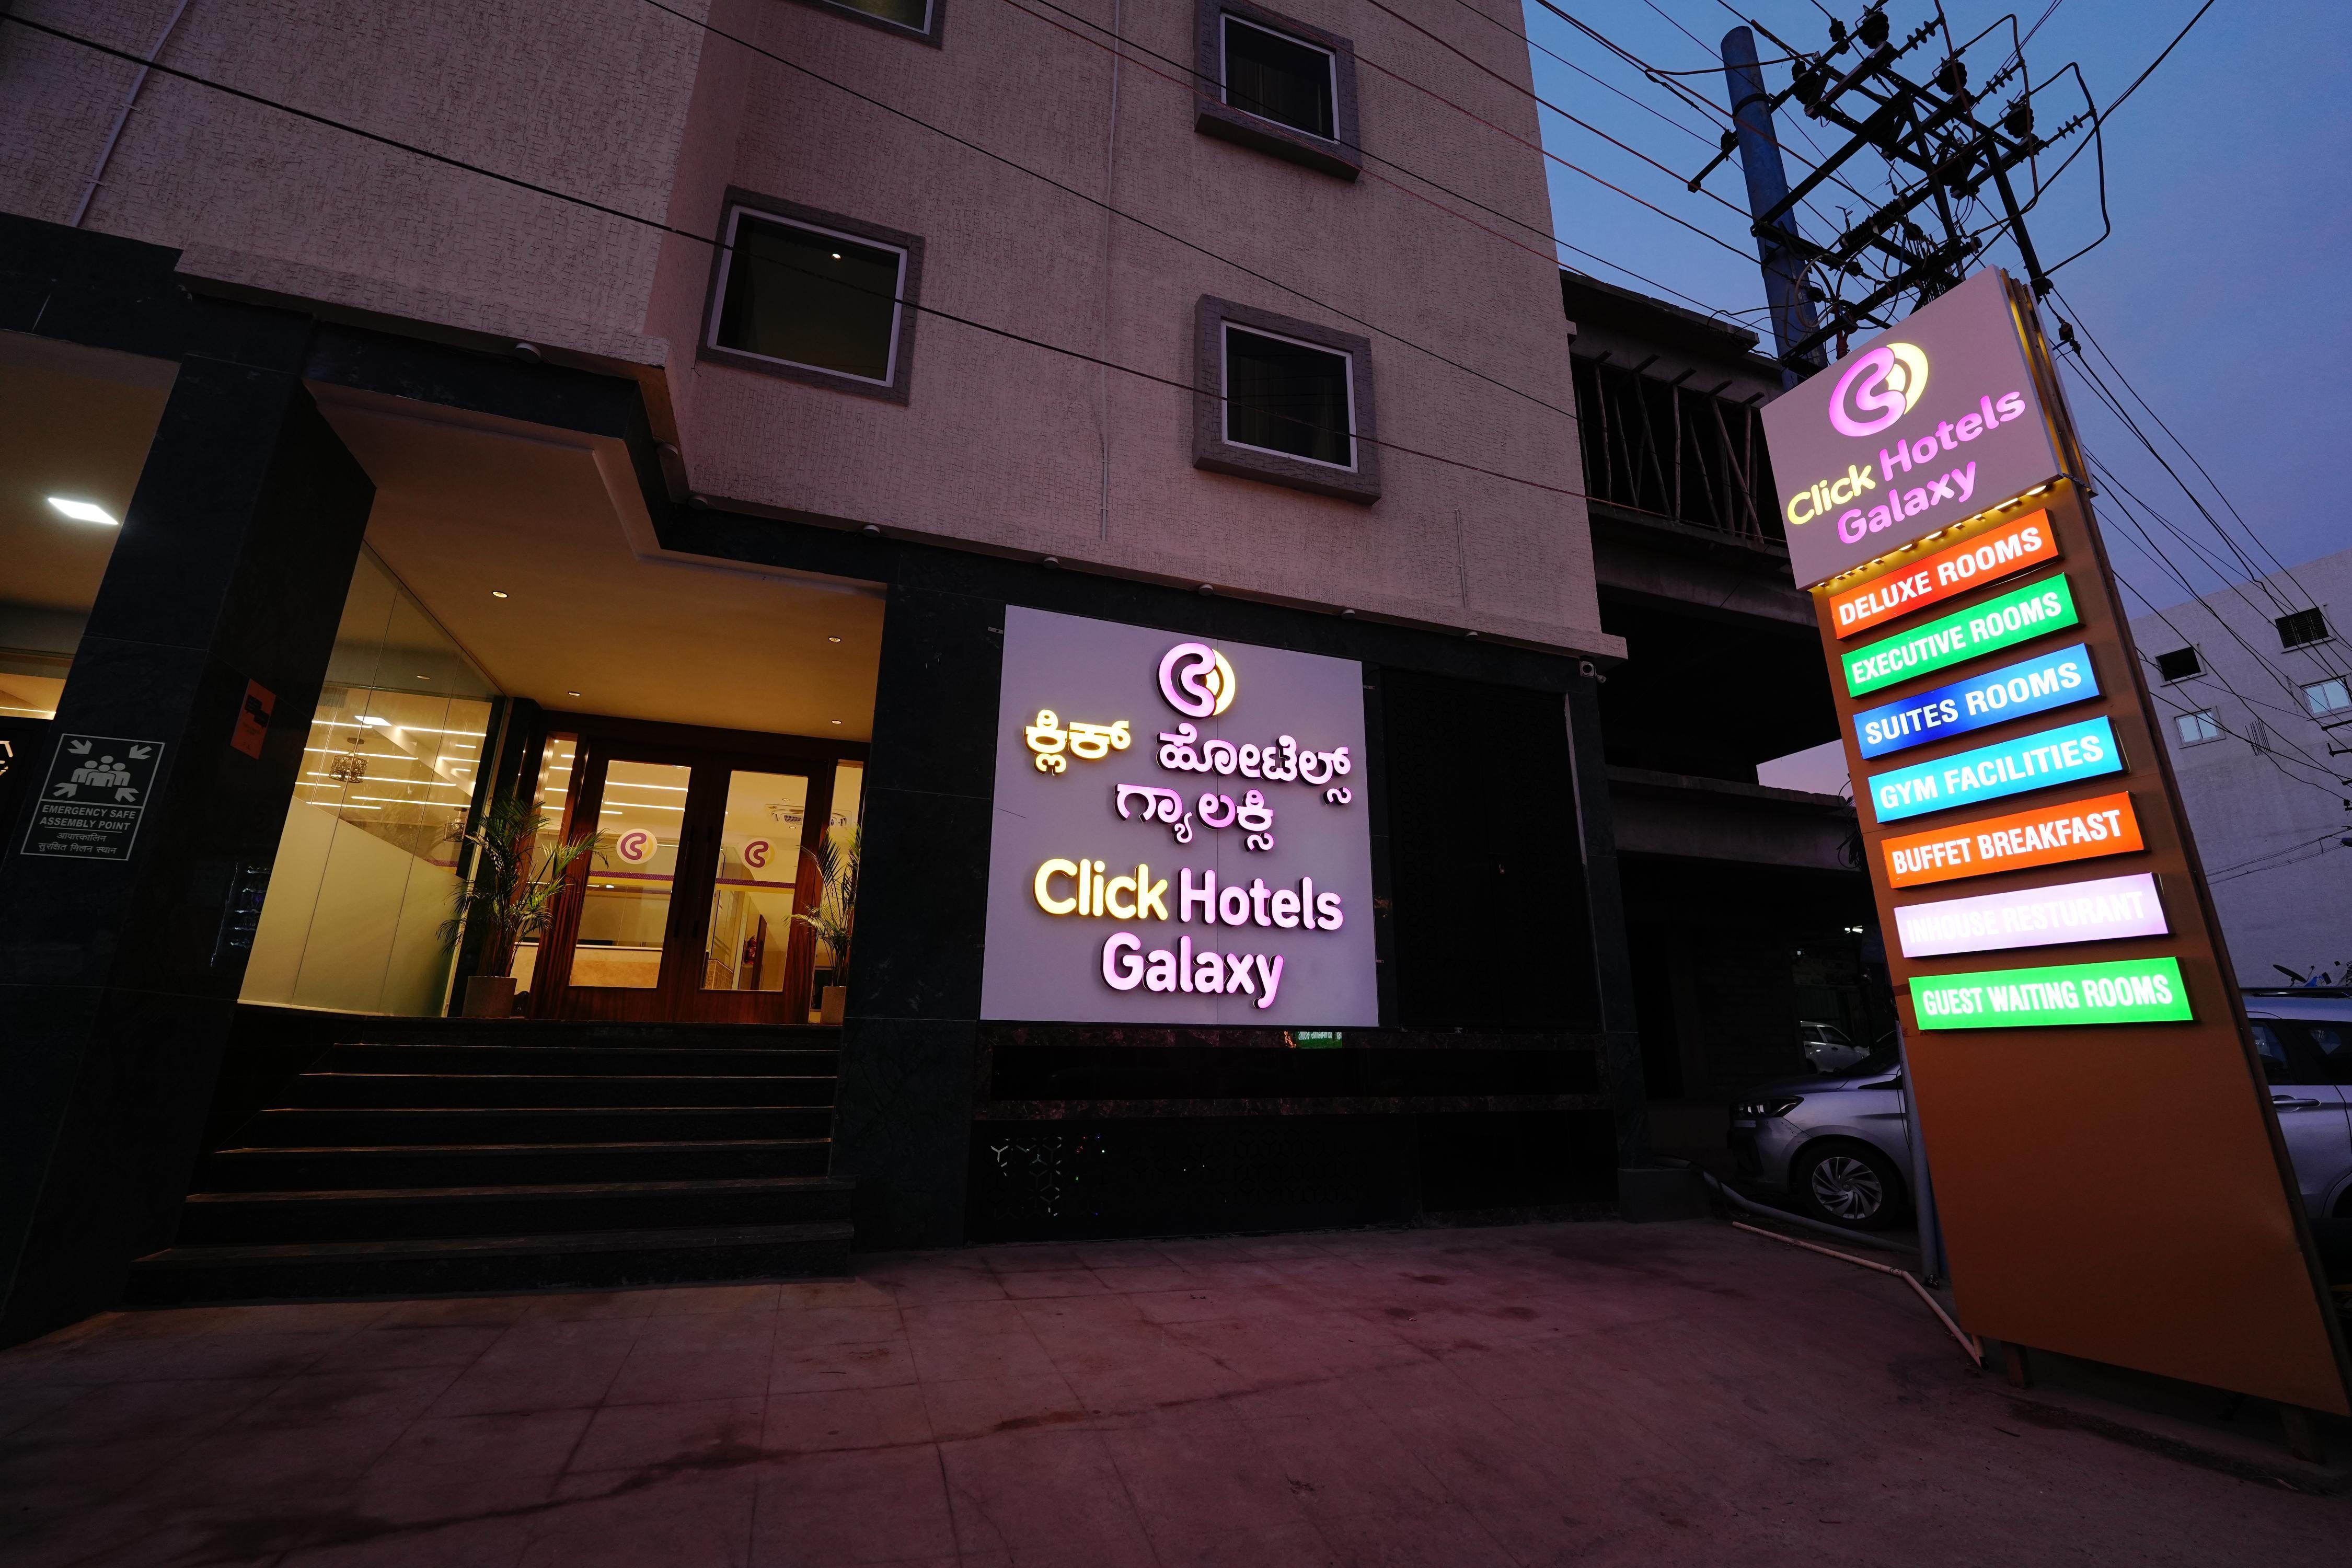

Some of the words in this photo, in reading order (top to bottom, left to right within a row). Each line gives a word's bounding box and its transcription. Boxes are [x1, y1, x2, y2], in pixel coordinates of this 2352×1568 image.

[1787, 464, 1876, 525] Click
[1878, 391, 2025, 481] Hotels
[1837, 462, 1976, 544] Galaxy
[1838, 571, 1932, 625] DELUXE
[1937, 526, 2043, 586] ROOMS
[1851, 627, 1966, 684] EXECUTIVE
[1969, 591, 2062, 648] ROOMS
[1864, 699, 1959, 745] SUITES
[1965, 662, 2082, 716] ROOMS
[1024, 709, 1131, 775] ಕ್ಲಿಕ್
[1880, 775, 1939, 809] GYM
[1944, 735, 2104, 794] FACILITIES
[38, 841, 67, 851] सुरक्षित
[70, 843, 94, 852] मिलन
[40, 817, 96, 828] ASSEMBLY
[98, 821, 131, 830] POINT
[42, 805, 108, 816] EMERGENCY
[110, 810, 136, 818] SAFE
[1115, 783, 1274, 852] ಗ್ಯಾಲಕ್ಸಿ
[1891, 838, 1971, 874] BUFFET
[1977, 809, 2121, 860] BREAKFAST
[1032, 858, 1168, 921] Click
[1177, 868, 1344, 930] Hotels
[1906, 910, 1999, 943] INHOUSE
[2002, 891, 2144, 933] RESTURANT
[1100, 932, 1284, 1009] Galaxy
[1922, 987, 1983, 1016] GUEST
[1987, 981, 2080, 1012] WAITING
[2082, 974, 2173, 1007] ROOMS
